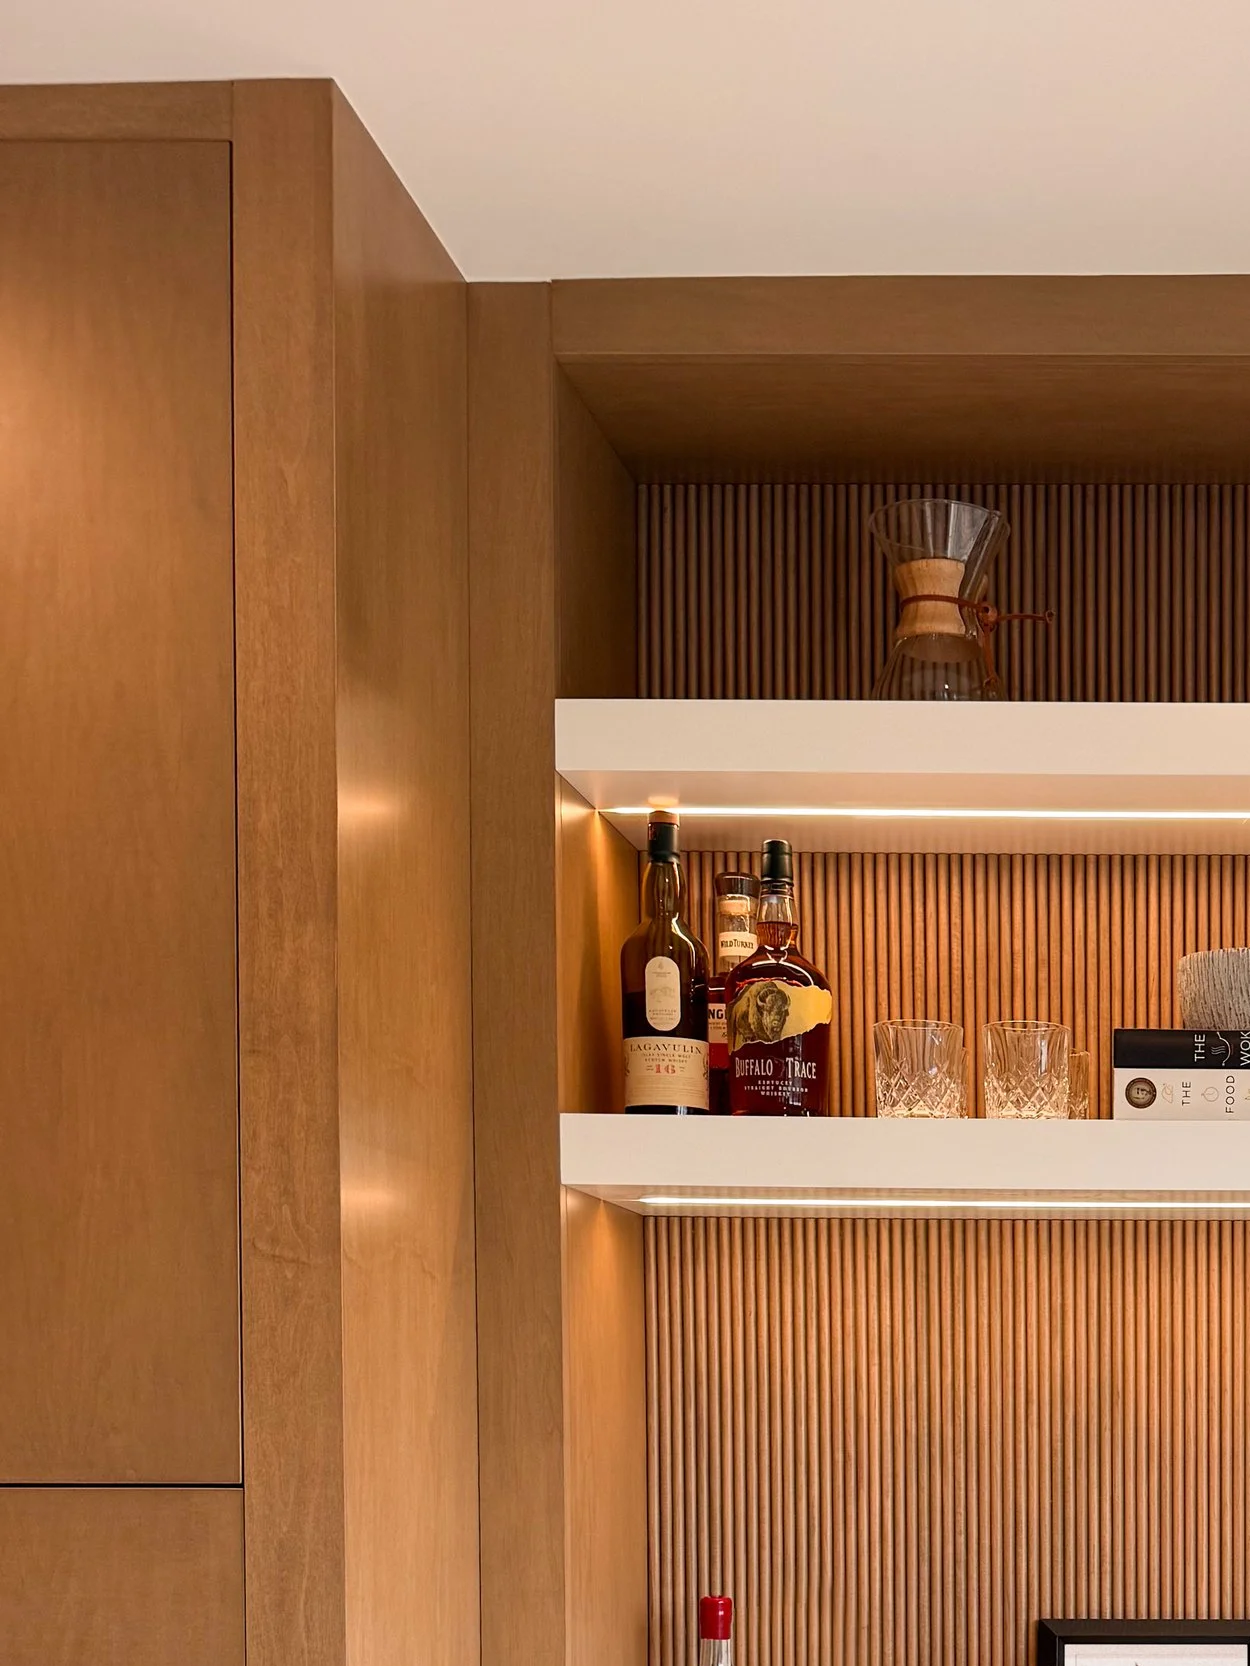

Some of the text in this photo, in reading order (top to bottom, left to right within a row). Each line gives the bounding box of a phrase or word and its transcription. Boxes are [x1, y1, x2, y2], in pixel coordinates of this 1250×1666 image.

[630, 1043, 702, 1055] LAGAVULIN
[1194, 1033, 1206, 1062] THE
[655, 1063, 676, 1074] 16
[735, 1057, 817, 1079] BUFFALO TRACE
[1181, 1081, 1192, 1106] THE
[1225, 1075, 1235, 1114] FOOD
